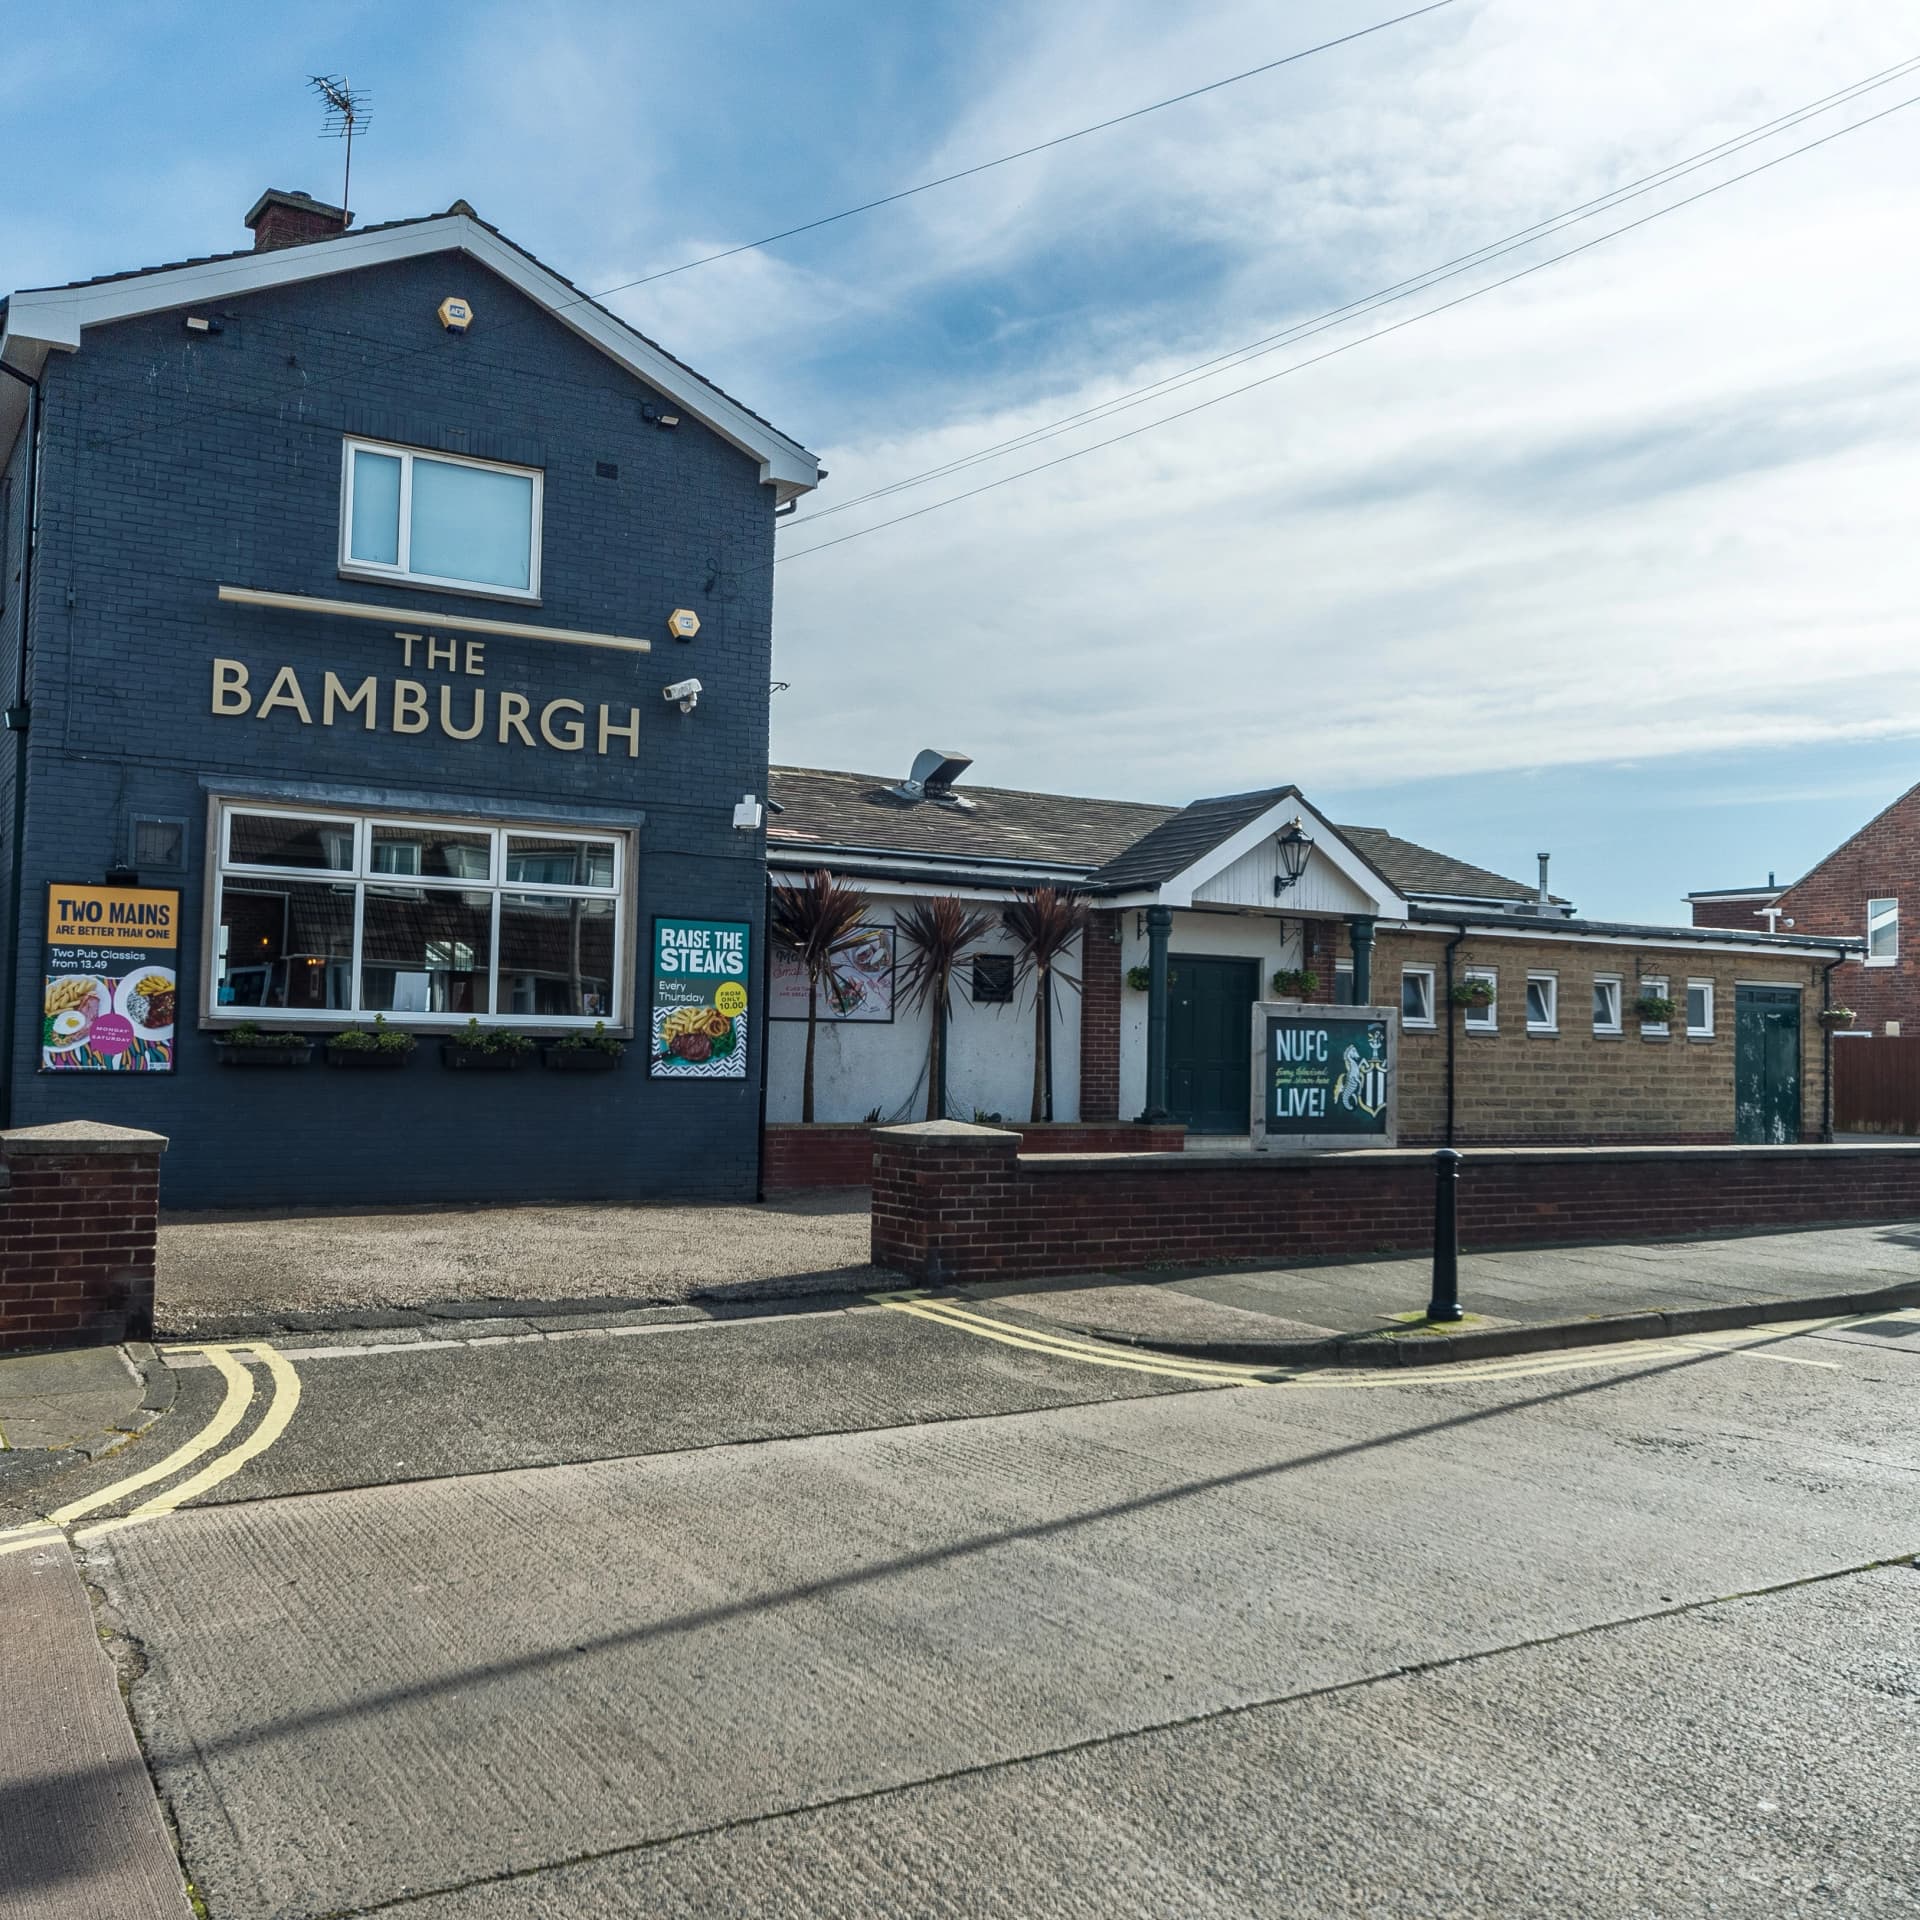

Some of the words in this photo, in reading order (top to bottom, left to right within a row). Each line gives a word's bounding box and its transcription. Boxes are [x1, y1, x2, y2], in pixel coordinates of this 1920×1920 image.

[395, 632, 485, 676] THE
[211, 658, 640, 758] BAMBURGH
[57, 900, 103, 922] TWO
[109, 902, 170, 926] MAINS
[56, 925, 75, 935] ARE
[78, 926, 115, 937] BETTER
[117, 928, 143, 938] THAN
[145, 929, 170, 939] ONE
[661, 928, 711, 949] RAISE
[714, 931, 743, 951] THE
[52, 948, 75, 958] Two
[77, 949, 98, 959] Pub
[101, 950, 146, 961] Classics
[52, 959, 78, 968] from
[81, 960, 108, 969] 13.49
[660, 948, 744, 975] STEAKS
[659, 981, 687, 992] Every
[659, 992, 705, 1004] Thursday
[719, 1002, 744, 1010] 10.00
[1275, 1029, 1329, 1062] NUFC
[1276, 1087, 1327, 1118] LIVE!
